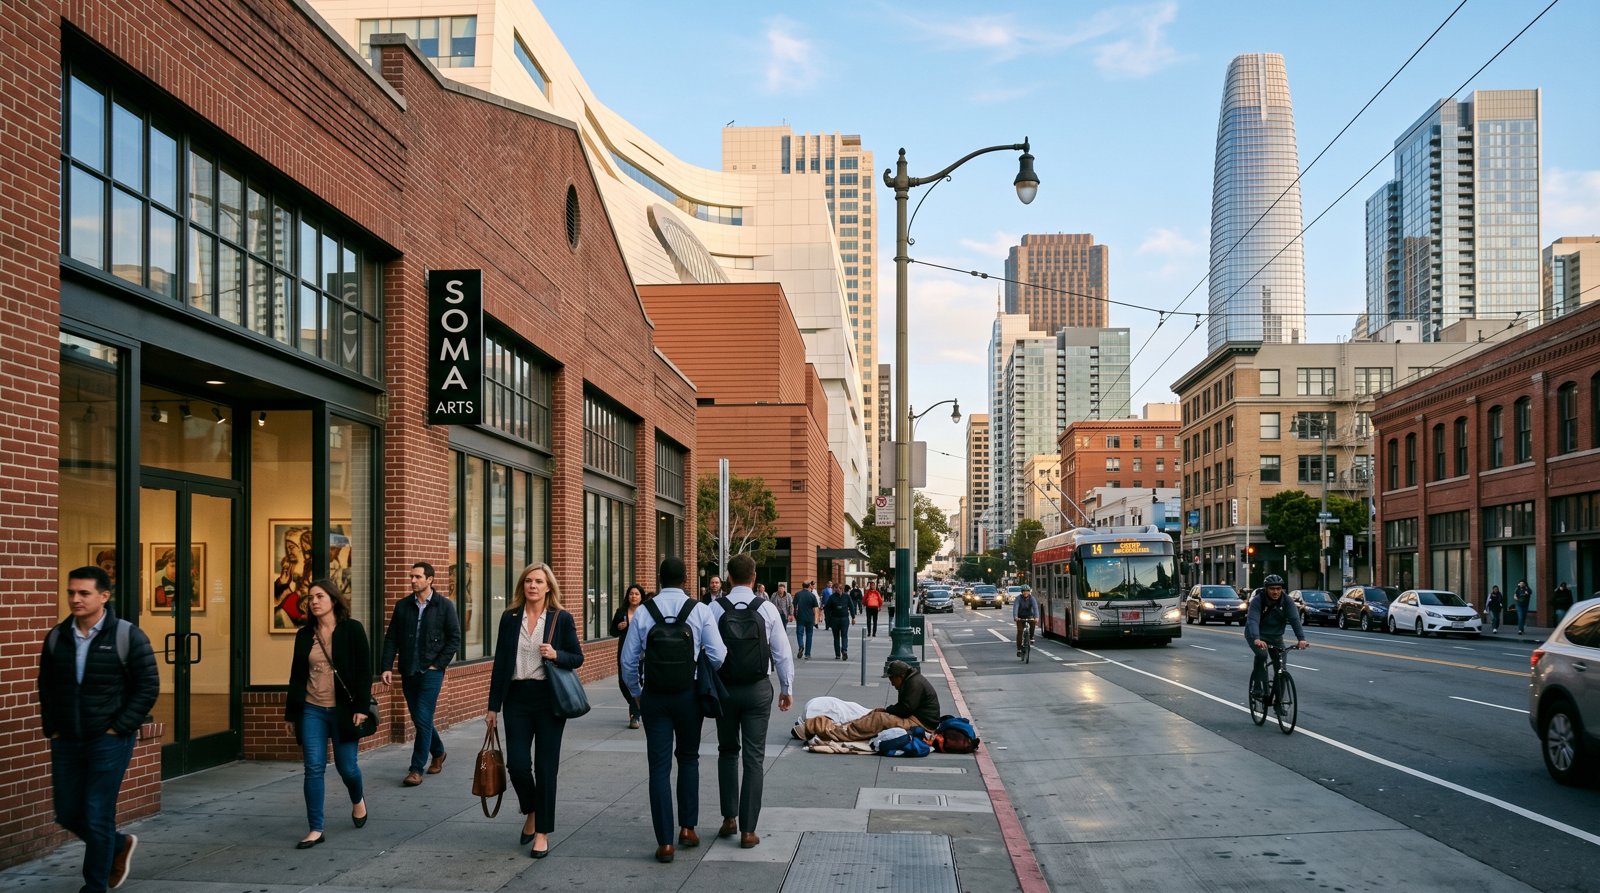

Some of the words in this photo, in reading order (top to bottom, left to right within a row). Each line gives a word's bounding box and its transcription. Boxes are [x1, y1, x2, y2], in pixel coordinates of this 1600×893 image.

[440, 280, 470, 390] SOMA
[435, 400, 474, 414] ARTS
[1092, 543, 1102, 555] 14
